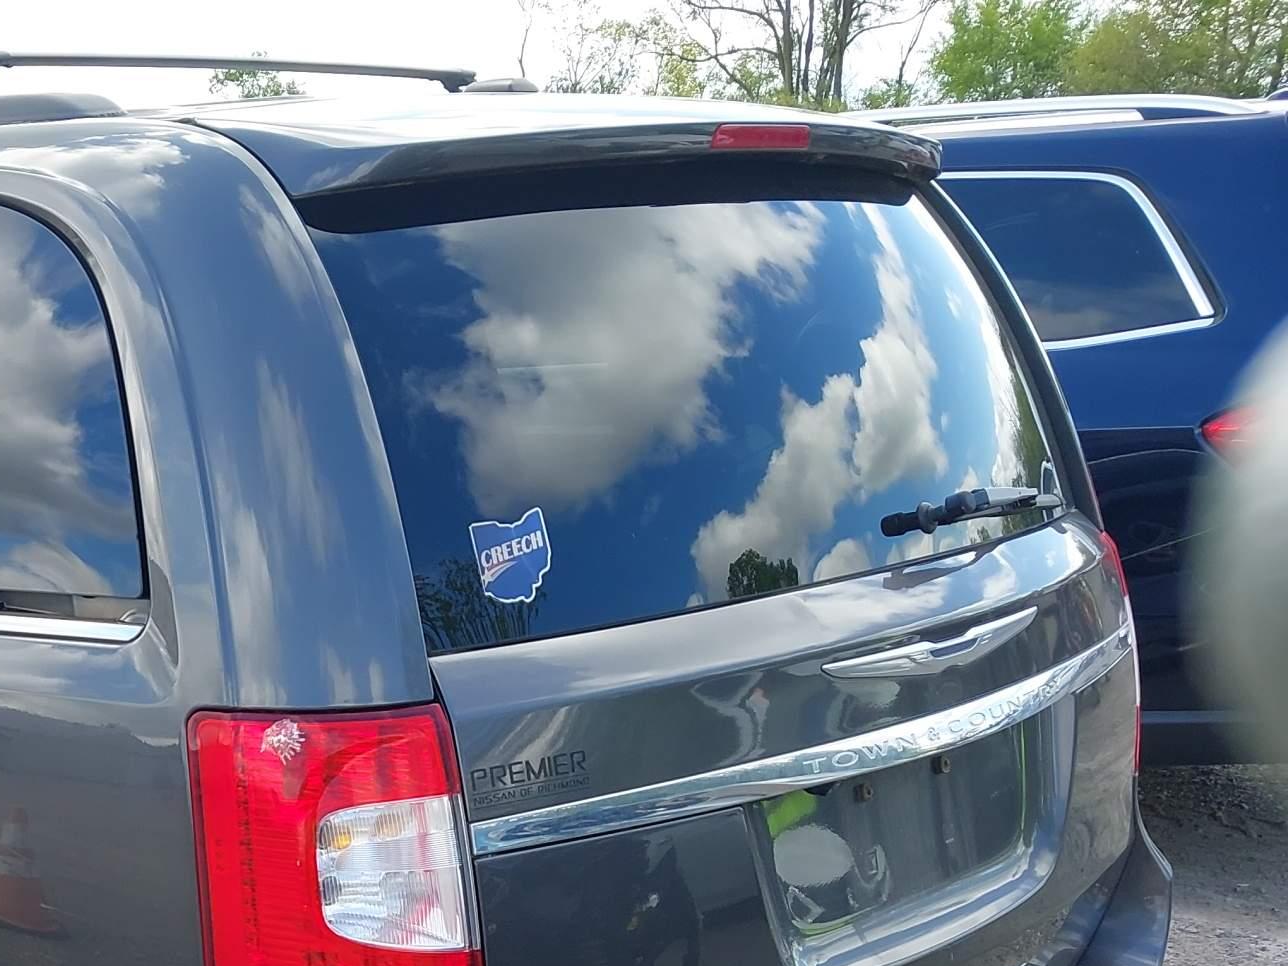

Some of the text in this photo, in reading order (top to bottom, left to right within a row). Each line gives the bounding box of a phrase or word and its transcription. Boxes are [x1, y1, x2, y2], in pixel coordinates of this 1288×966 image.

[480, 530, 544, 568] CREECH
[803, 678, 1063, 775] TOWN & COUNTRY
[470, 750, 587, 793] PREMIER
[473, 789, 516, 807] NISSAN
[520, 785, 534, 798] OF
